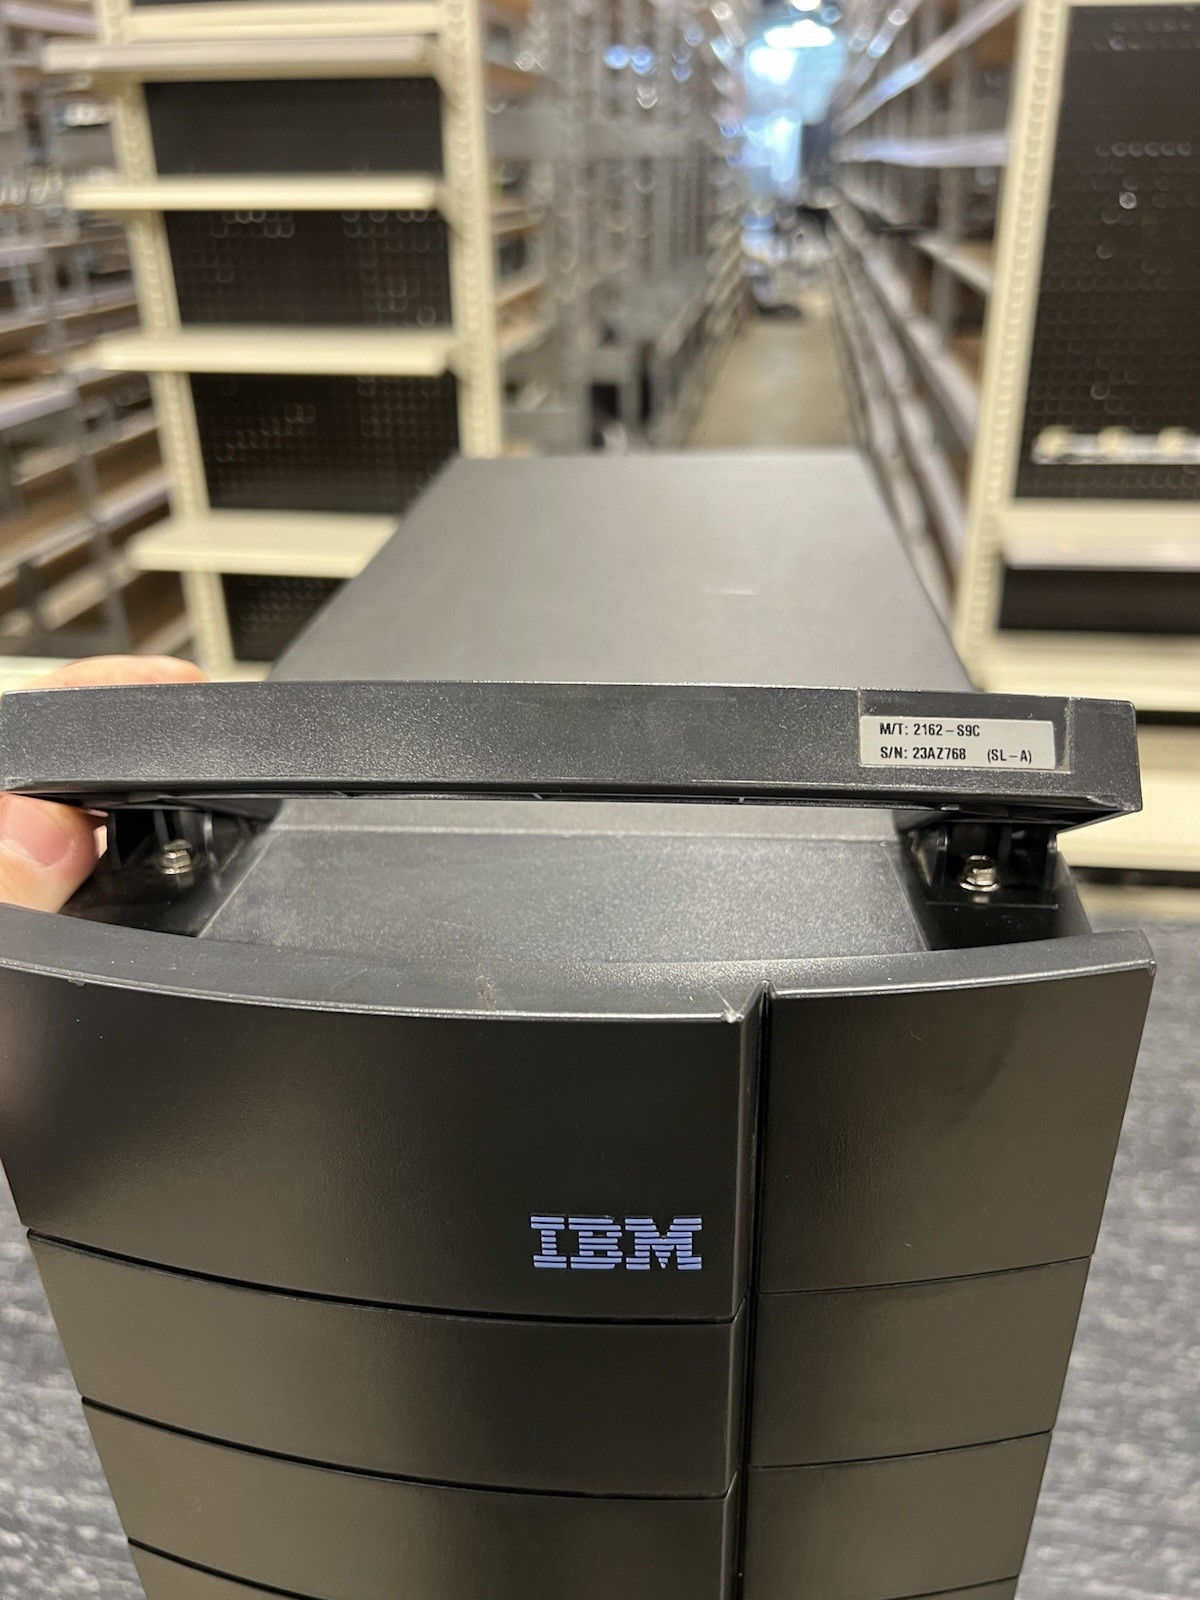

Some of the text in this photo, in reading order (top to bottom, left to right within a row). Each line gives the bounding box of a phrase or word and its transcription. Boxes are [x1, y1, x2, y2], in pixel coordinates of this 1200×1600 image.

[879, 722, 981, 738] M/T: 2162-S9C
[880, 746, 1033, 765] S/N: 23AZ768 (SL-A)
[530, 1215, 703, 1271] IBM
